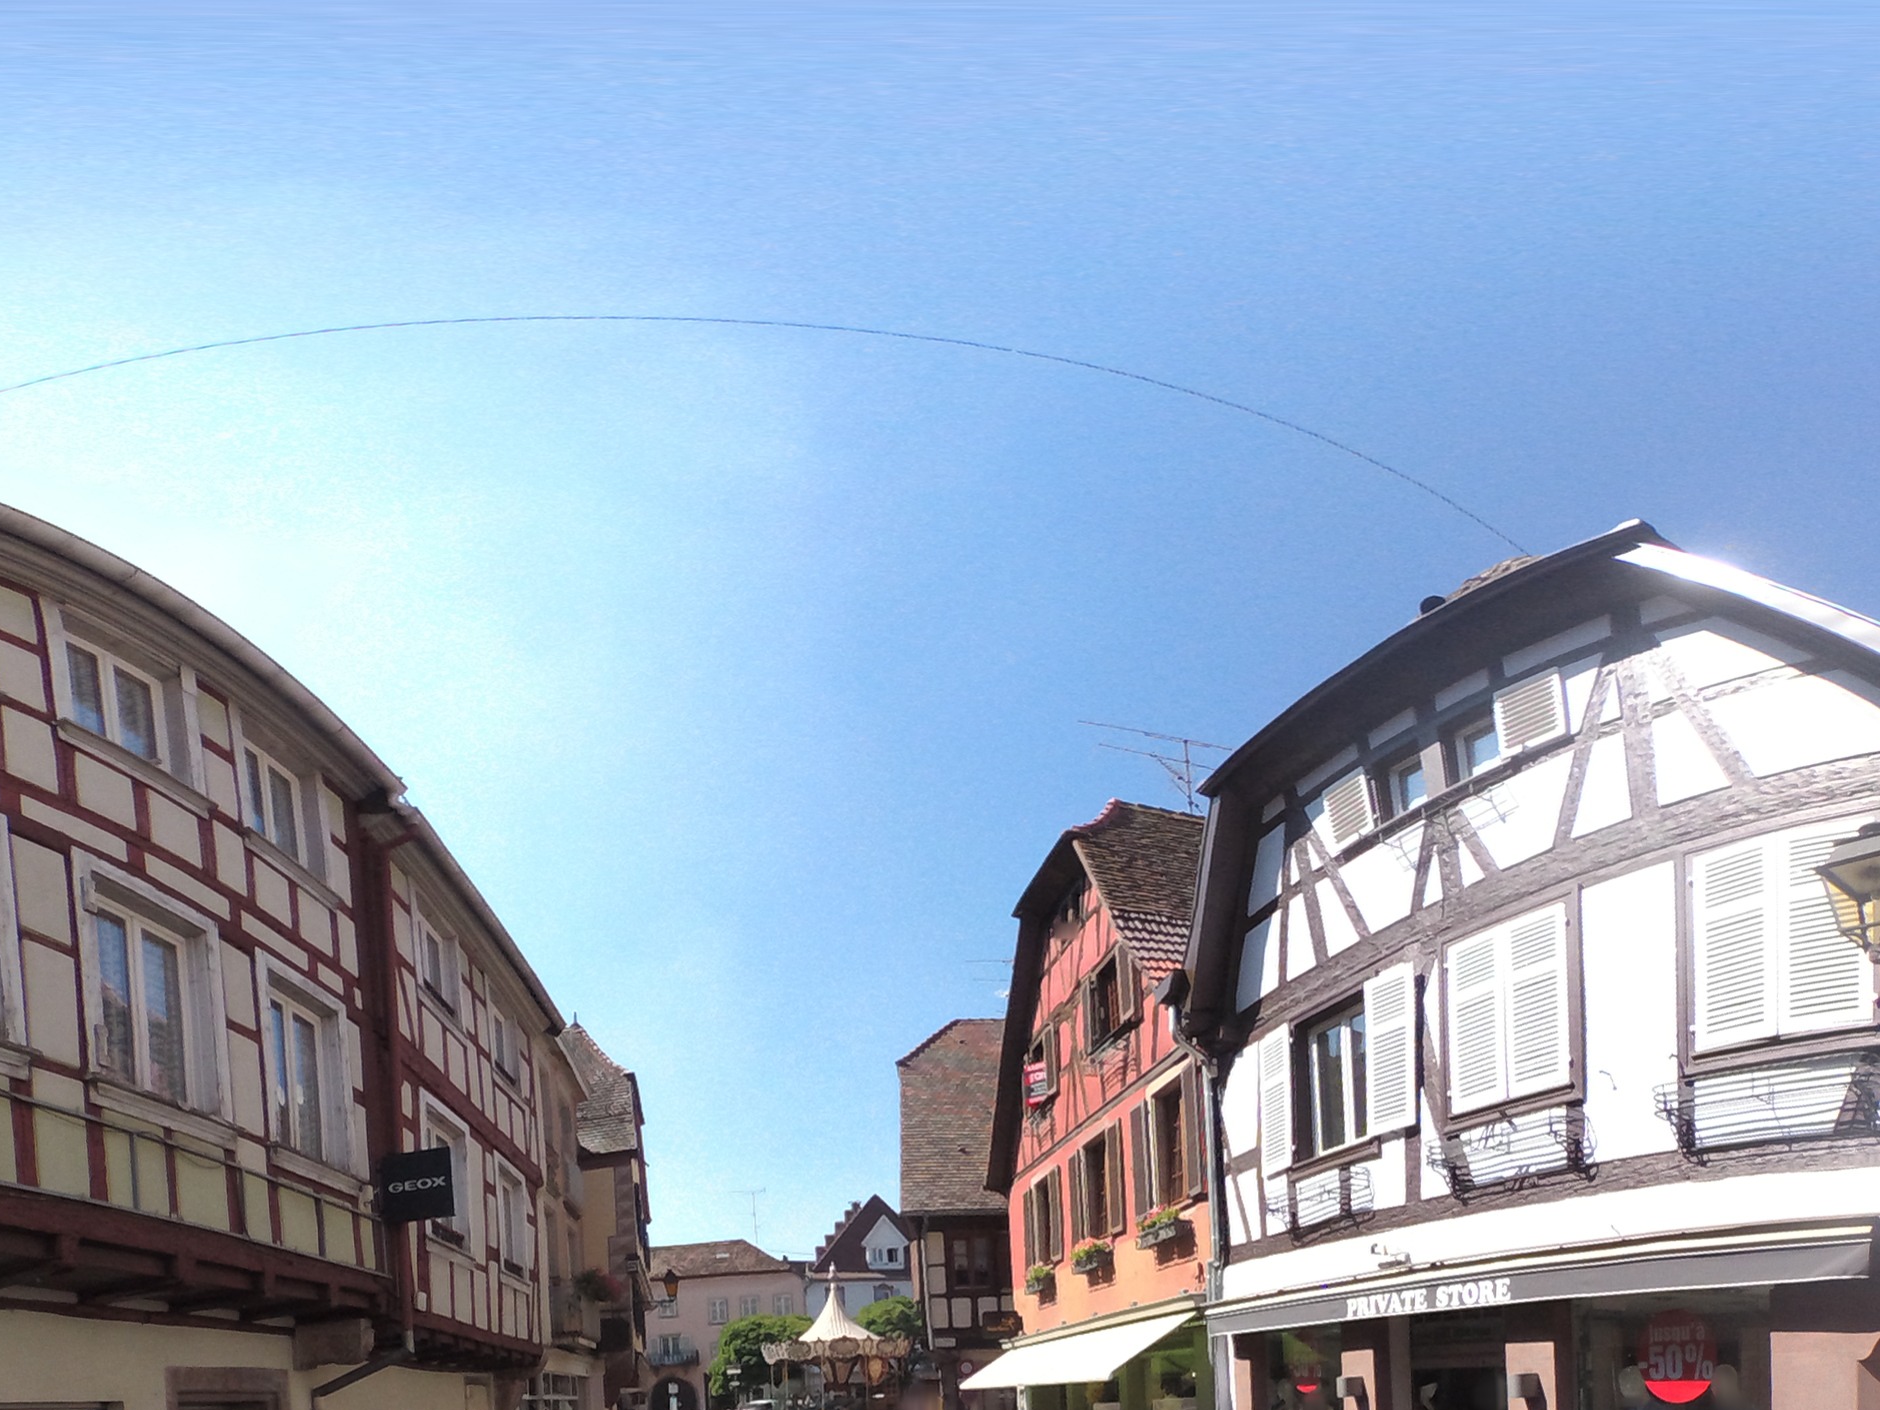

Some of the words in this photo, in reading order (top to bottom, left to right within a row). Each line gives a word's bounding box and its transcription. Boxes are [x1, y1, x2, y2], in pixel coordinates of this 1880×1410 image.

[388, 1173, 447, 1195] GEOX
[1345, 1287, 1428, 1319] PRIVATE
[1435, 1278, 1511, 1307] STORE
[1637, 1342, 1714, 1381] -50%
